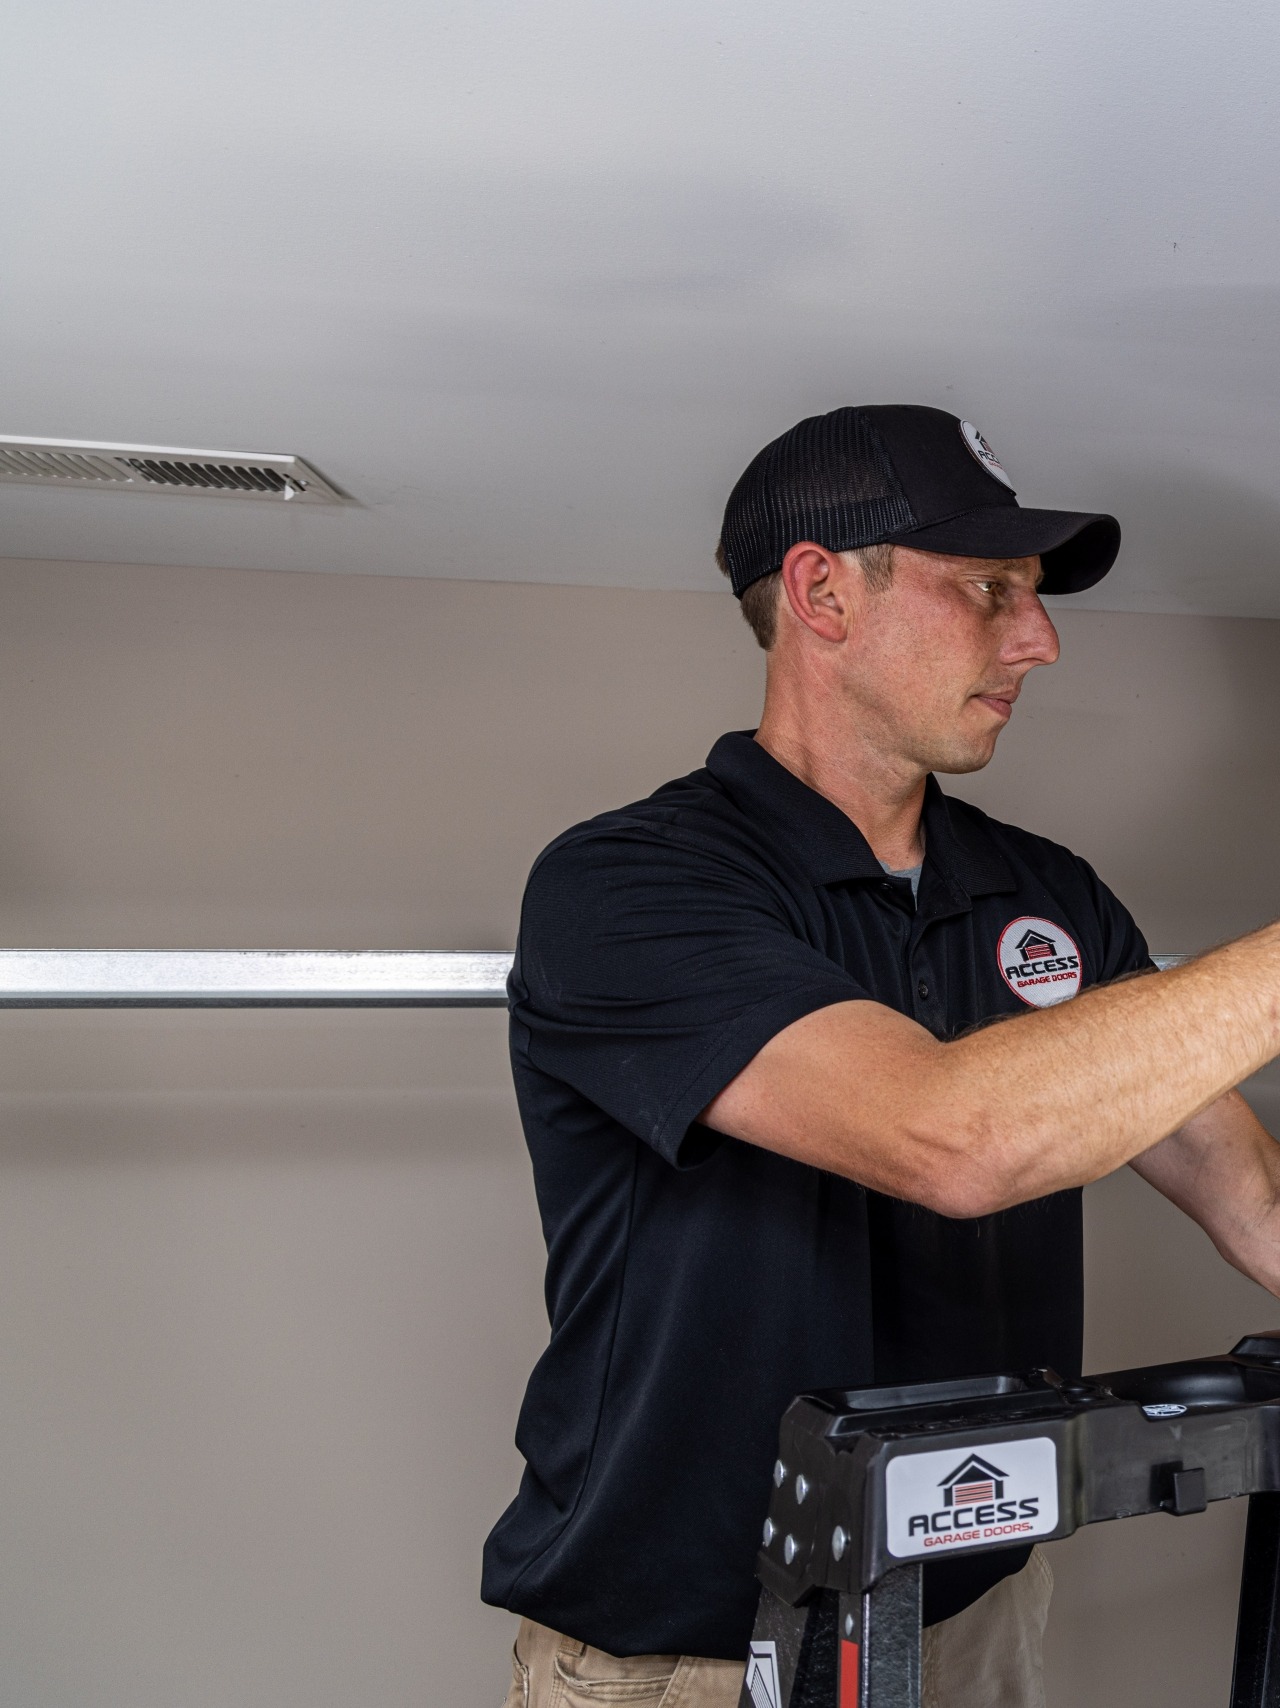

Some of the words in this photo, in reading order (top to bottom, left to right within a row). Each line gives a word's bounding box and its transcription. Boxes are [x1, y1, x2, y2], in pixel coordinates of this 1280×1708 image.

[1005, 955, 1079, 980] ACCESS
[1017, 976, 1050, 987] GARAGE
[1052, 972, 1077, 982] DOORS
[908, 1497, 1039, 1537] ACCESS
[924, 1530, 980, 1547] GARAGE
